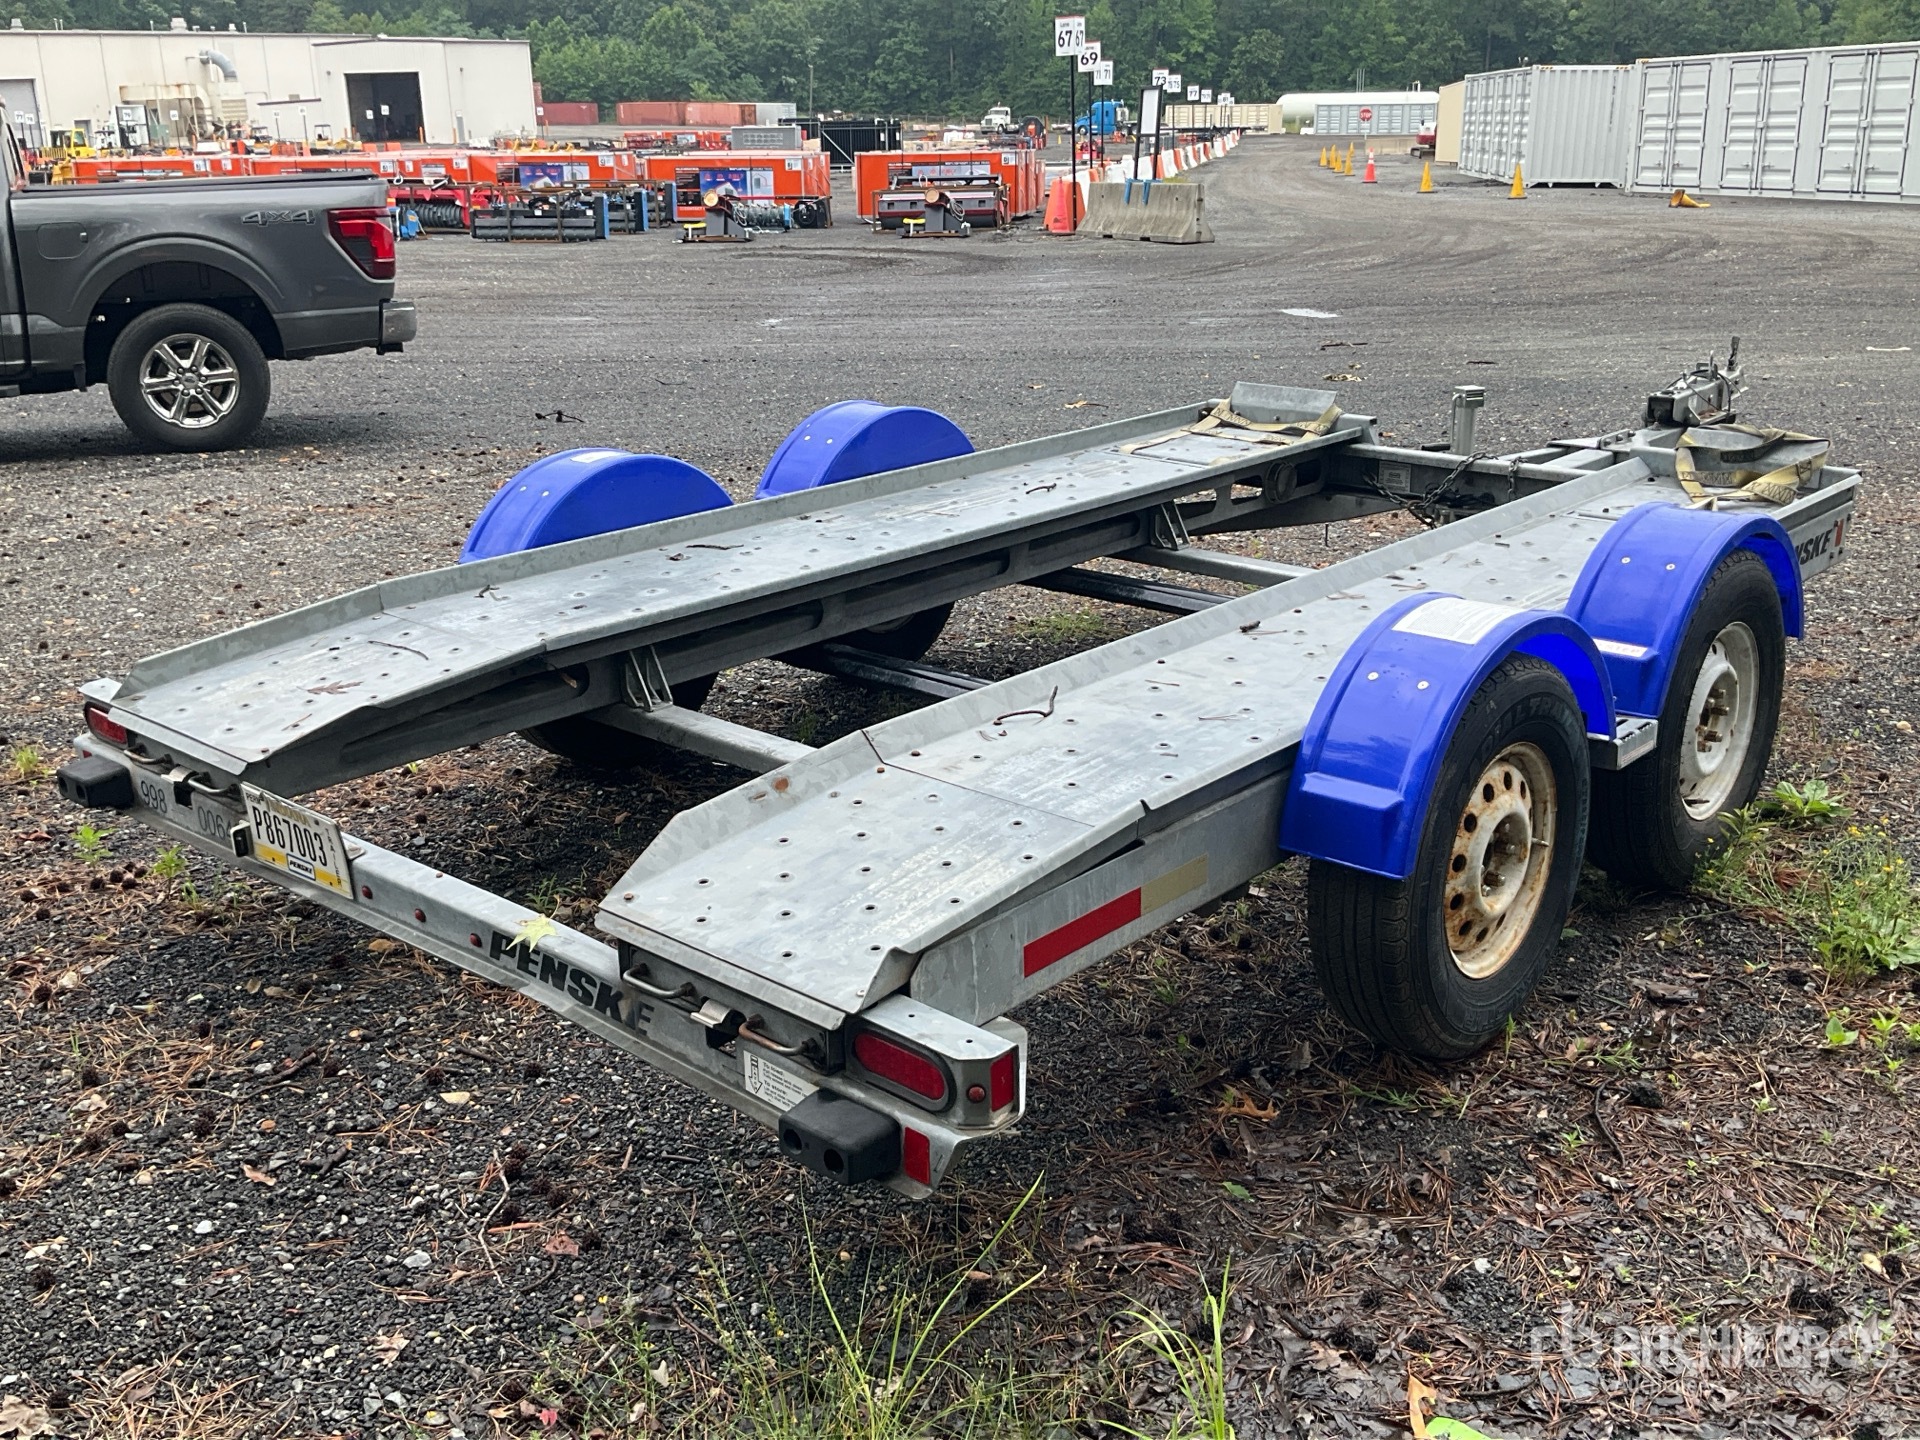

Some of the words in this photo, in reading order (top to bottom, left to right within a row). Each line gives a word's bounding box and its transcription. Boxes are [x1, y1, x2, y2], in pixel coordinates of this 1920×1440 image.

[1058, 30, 1072, 48] 67
[1075, 30, 1084, 47] 67
[1081, 52, 1098, 66] 69
[1104, 69, 1111, 80] 71
[1154, 76, 1167, 86] 73
[1795, 529, 1833, 566] NSKE
[141, 780, 168, 814] 998
[252, 805, 328, 867] P867003
[289, 860, 313, 875] PENSKE
[489, 930, 655, 1037] PENSKE
